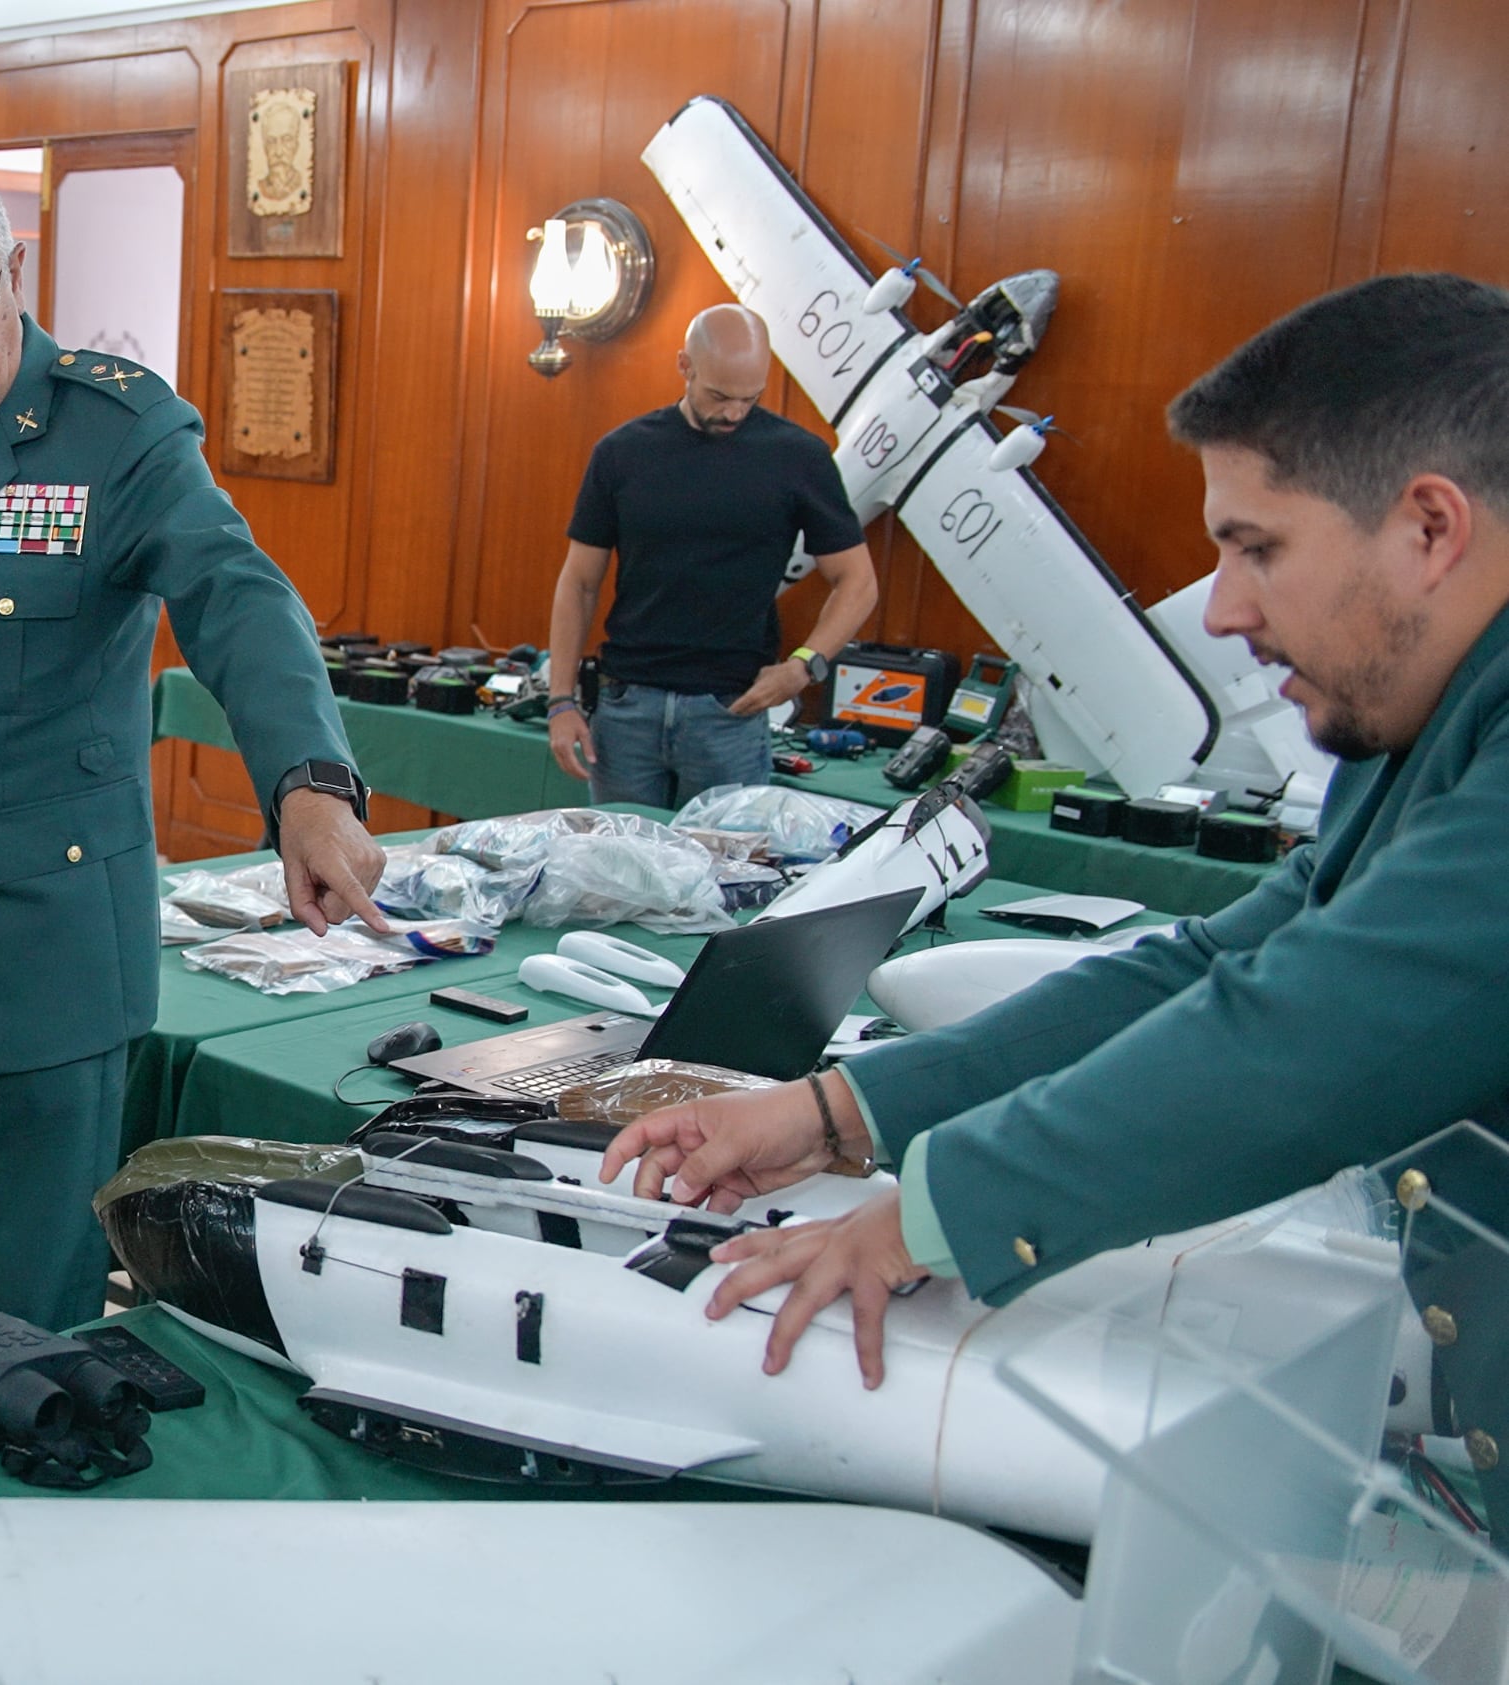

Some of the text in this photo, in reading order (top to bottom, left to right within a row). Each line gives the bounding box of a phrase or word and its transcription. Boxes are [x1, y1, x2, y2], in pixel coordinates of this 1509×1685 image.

[798, 290, 865, 378] 109
[853, 414, 898, 469] 109
[940, 488, 1004, 560] 109
